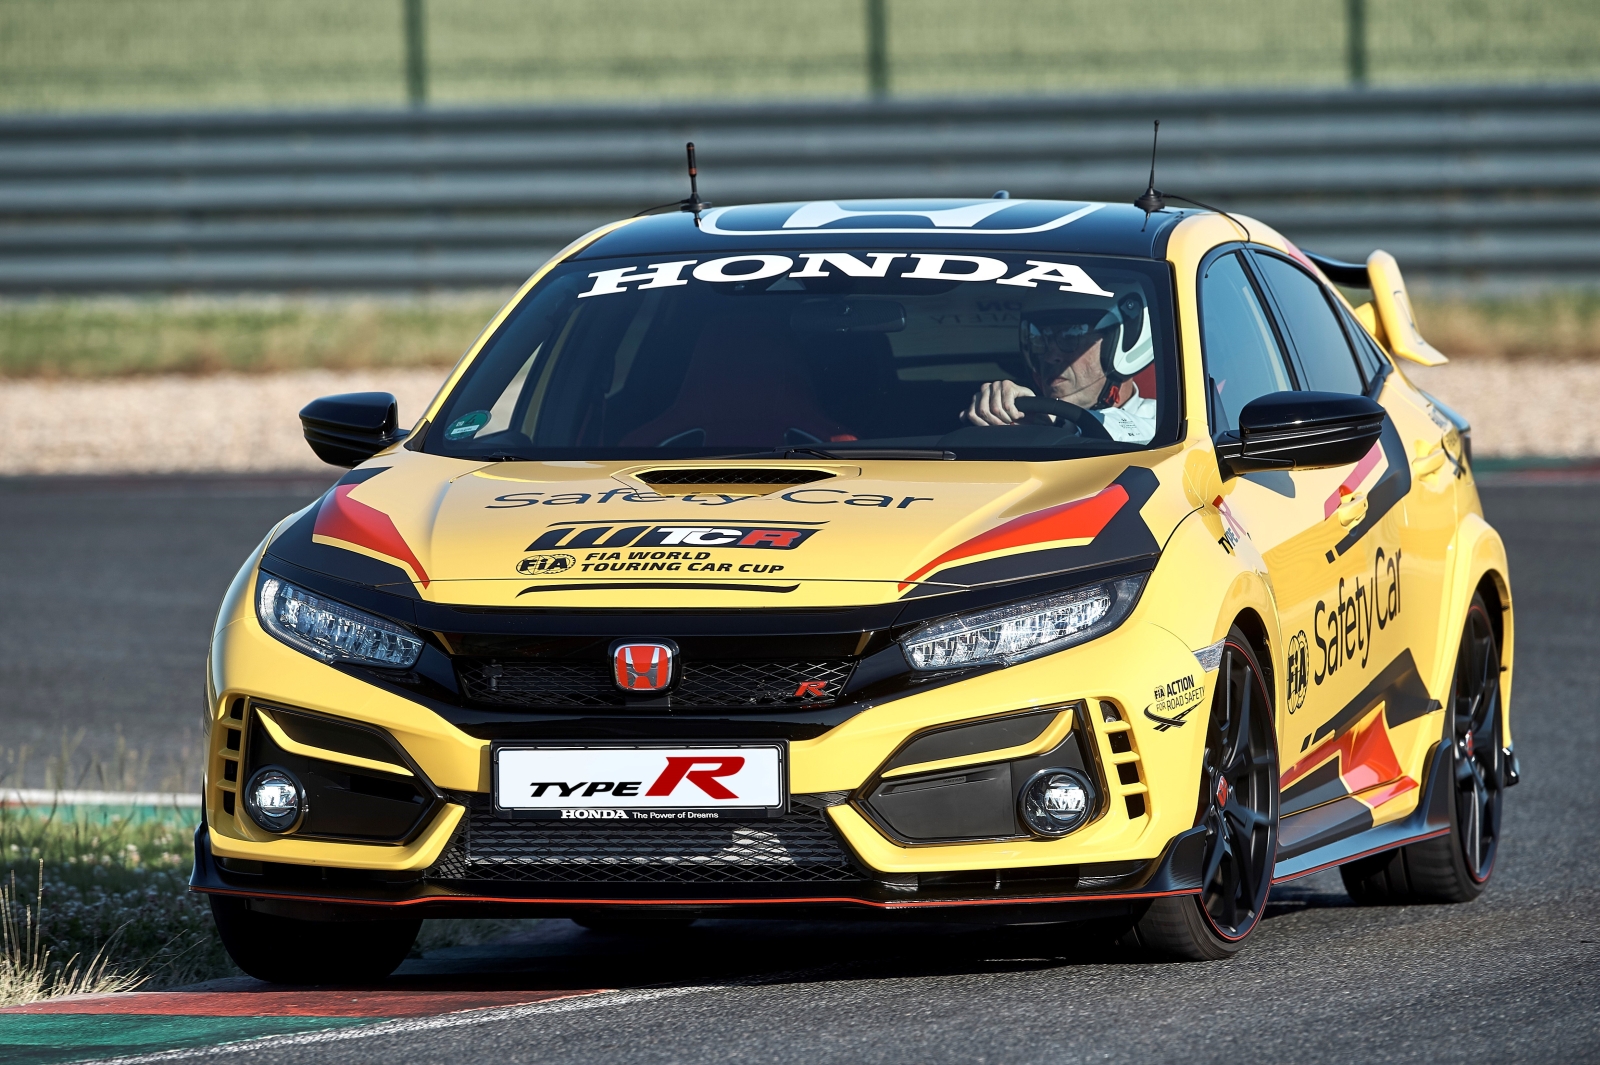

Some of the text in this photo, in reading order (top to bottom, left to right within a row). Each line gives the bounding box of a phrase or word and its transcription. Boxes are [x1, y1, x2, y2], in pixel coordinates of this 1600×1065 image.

[578, 253, 1114, 298] HONDA
[781, 488, 935, 509] Car
[585, 551, 711, 561] FIA WORLD
[580, 562, 785, 574] TOURING CAR CUP
[1314, 577, 1373, 687] Safety
[1375, 546, 1401, 631] Car
[794, 680, 828, 697] R
[1166, 674, 1194, 698] ACTION
[1156, 685, 1205, 712] FOR ROAD SAFETY
[529, 756, 746, 799] TYPE R
[560, 809, 719, 819] HONDA The Power of Dreams
